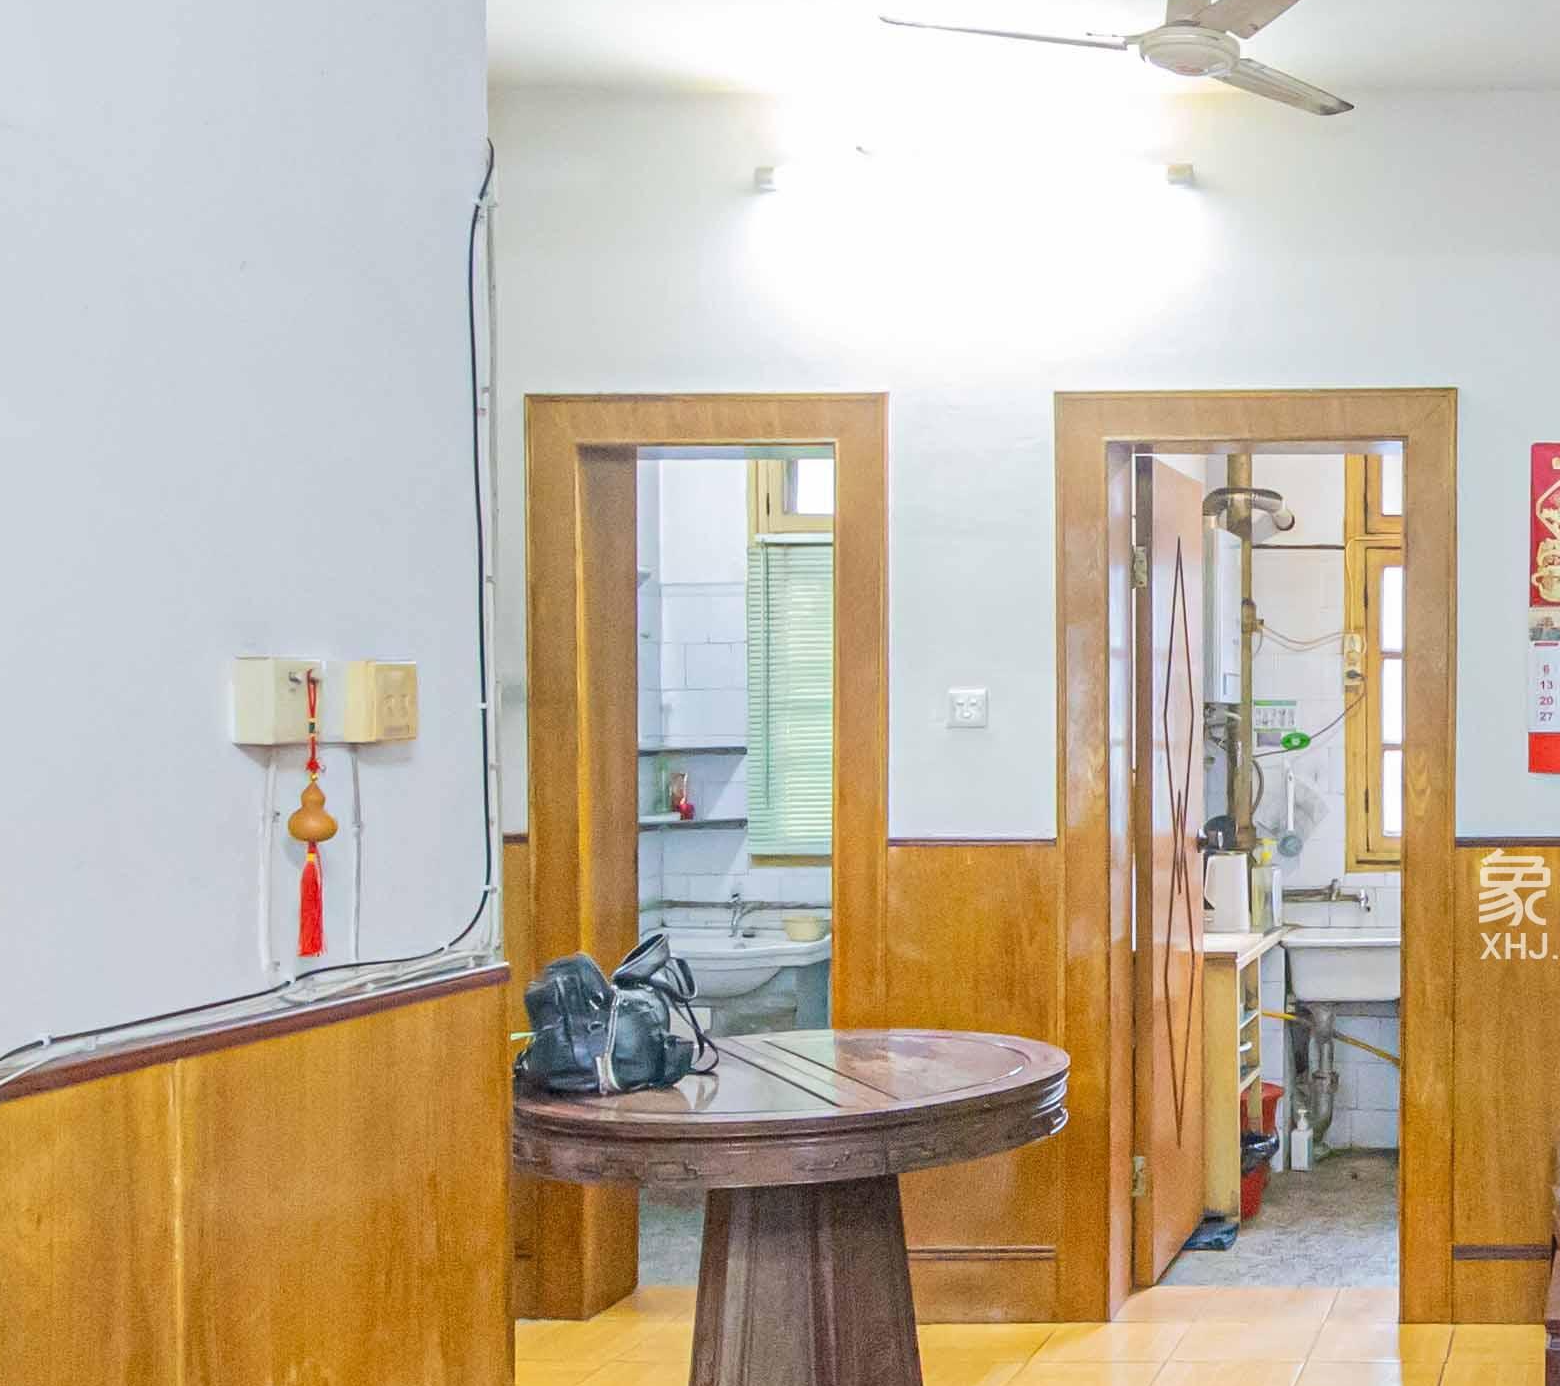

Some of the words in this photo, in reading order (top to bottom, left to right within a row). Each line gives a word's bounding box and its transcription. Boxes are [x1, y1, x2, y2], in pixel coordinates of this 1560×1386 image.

[1541, 680, 1553, 690] 13
[1539, 695, 1554, 706] 20
[1539, 711, 1553, 722] 27
